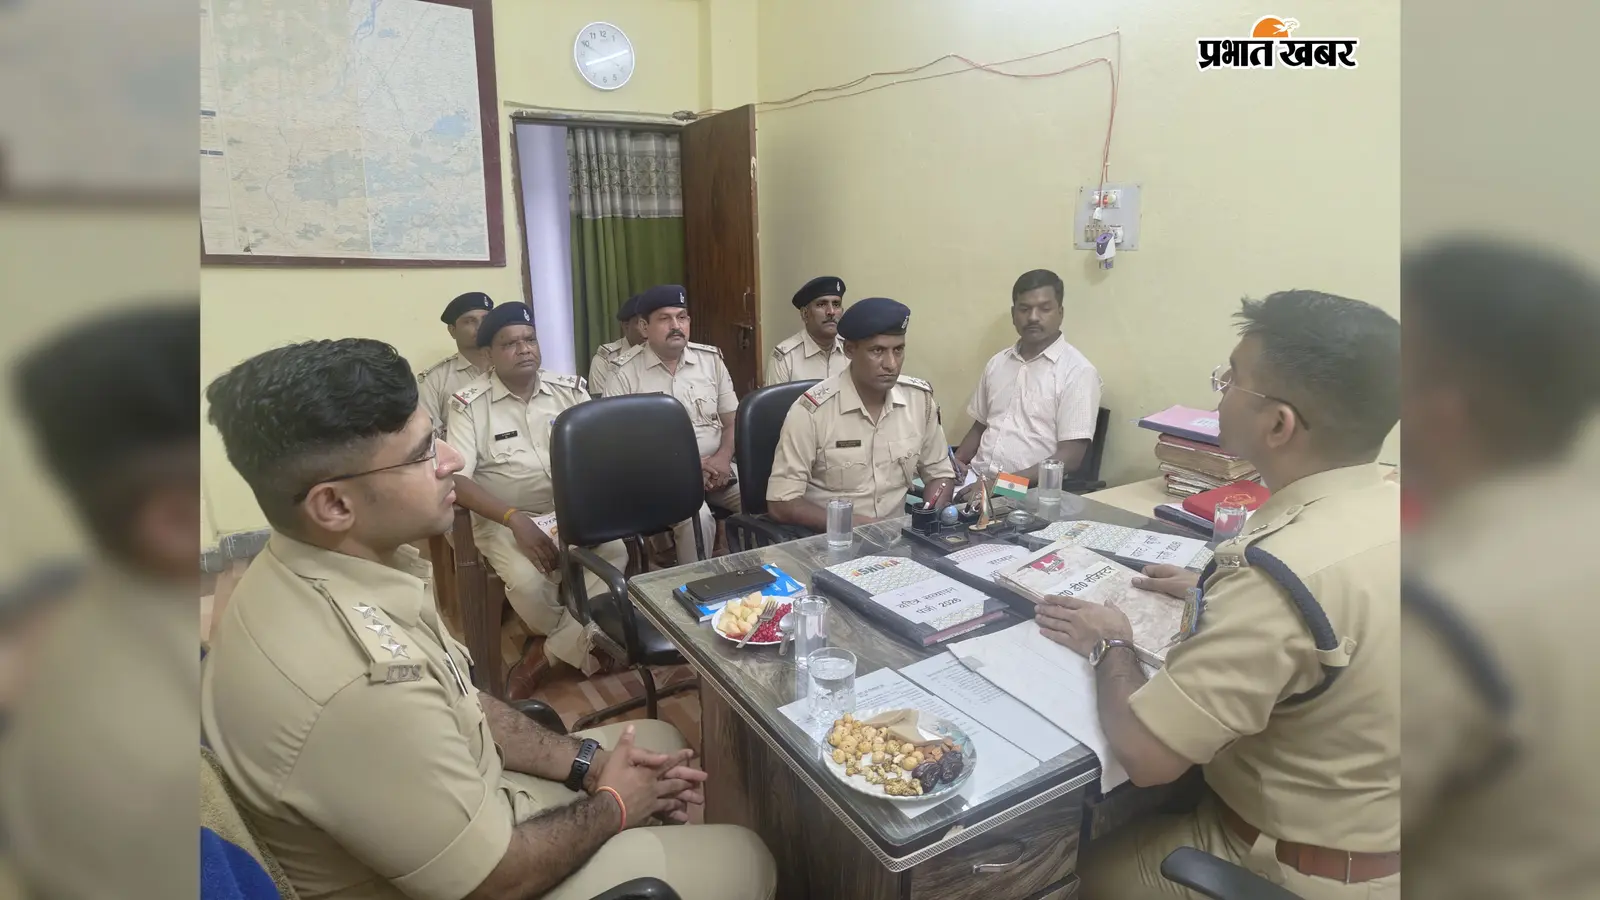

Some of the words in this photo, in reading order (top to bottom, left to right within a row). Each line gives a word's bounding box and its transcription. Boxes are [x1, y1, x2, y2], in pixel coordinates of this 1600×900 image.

[589, 32, 596, 40] 11
[599, 30, 607, 38] 12
[1084, 565, 1116, 584] रजिस्टर
[938, 597, 962, 608] 2026
